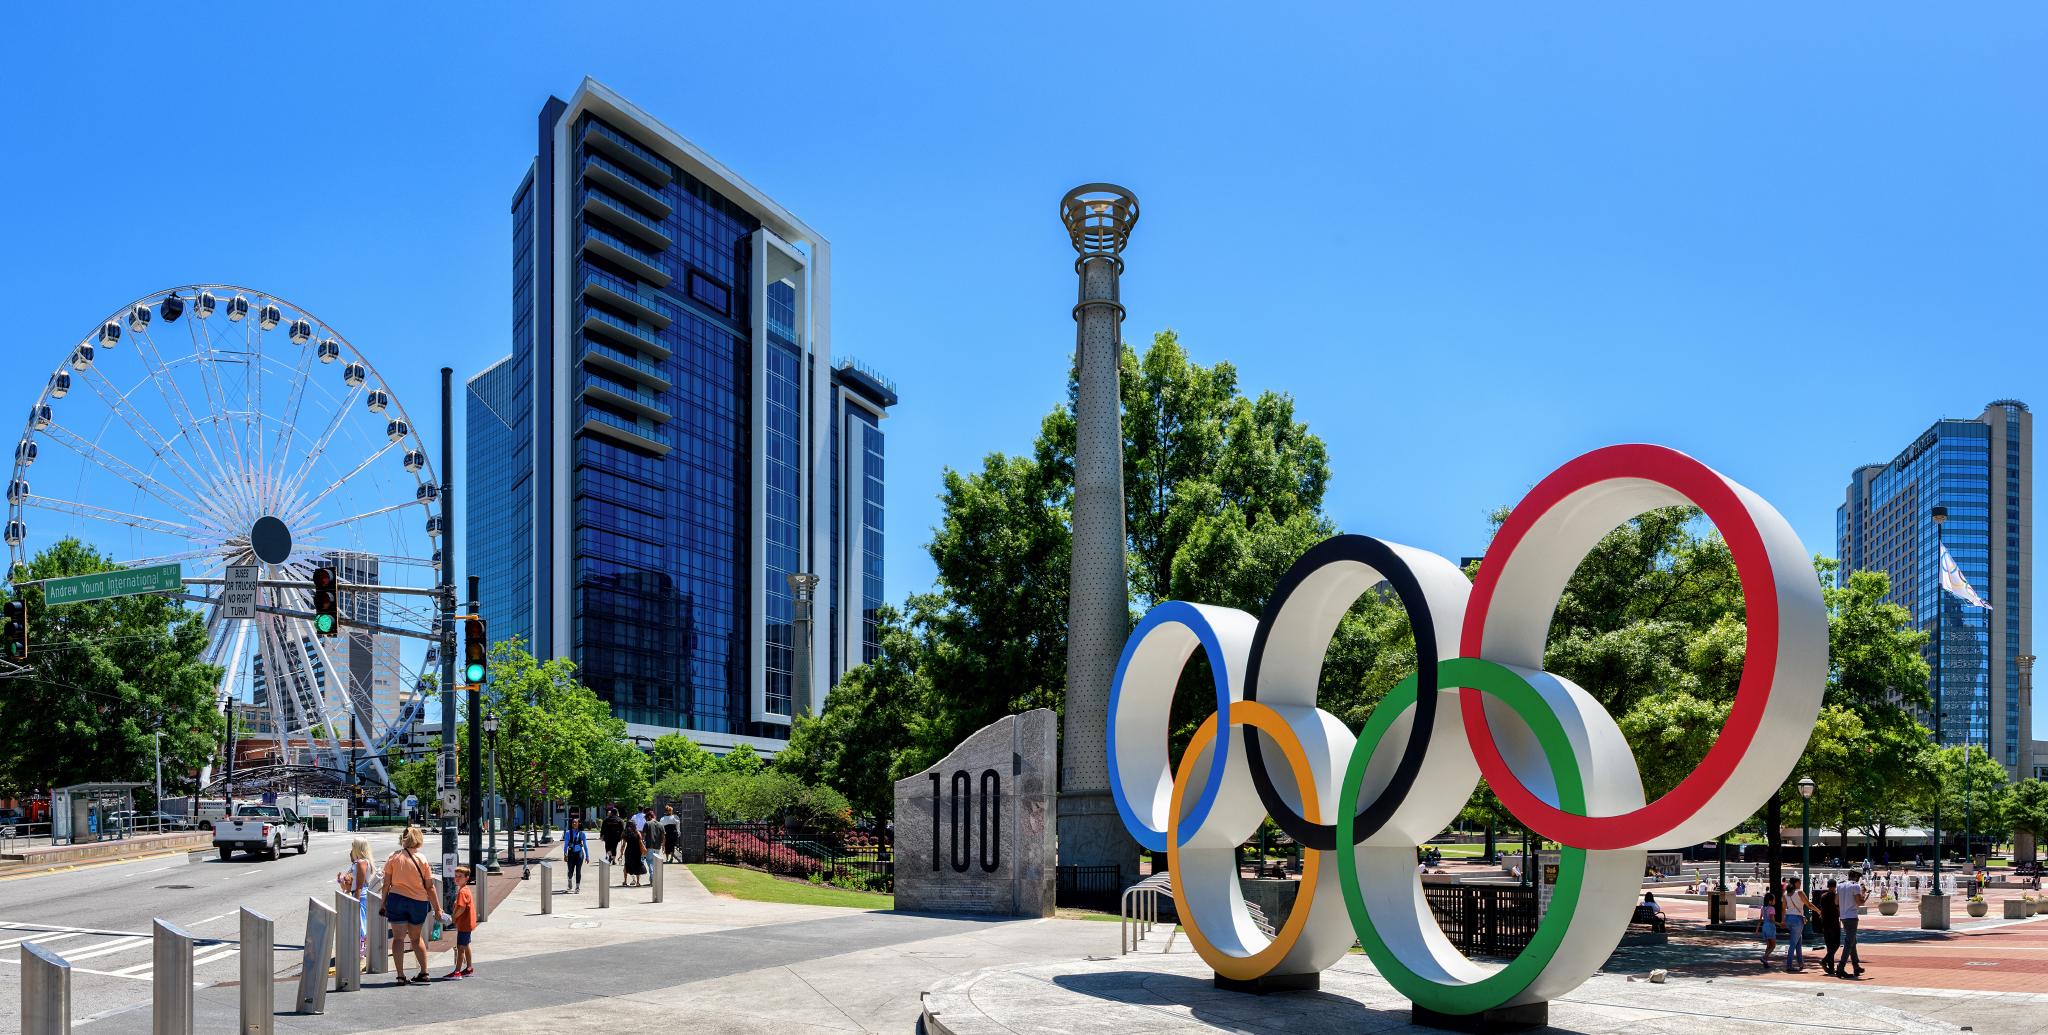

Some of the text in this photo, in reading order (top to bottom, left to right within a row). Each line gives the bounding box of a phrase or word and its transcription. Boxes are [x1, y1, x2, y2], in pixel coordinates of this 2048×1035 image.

[163, 566, 177, 576] BLVD
[235, 569, 249, 578] BUSES
[51, 572, 159, 598] Andrew Young International
[165, 580, 174, 588] NW
[226, 581, 256, 591] OR TRUCKS
[227, 593, 253, 604] NO RIGHT
[231, 606, 248, 616] TURN
[929, 768, 1001, 873] 100
